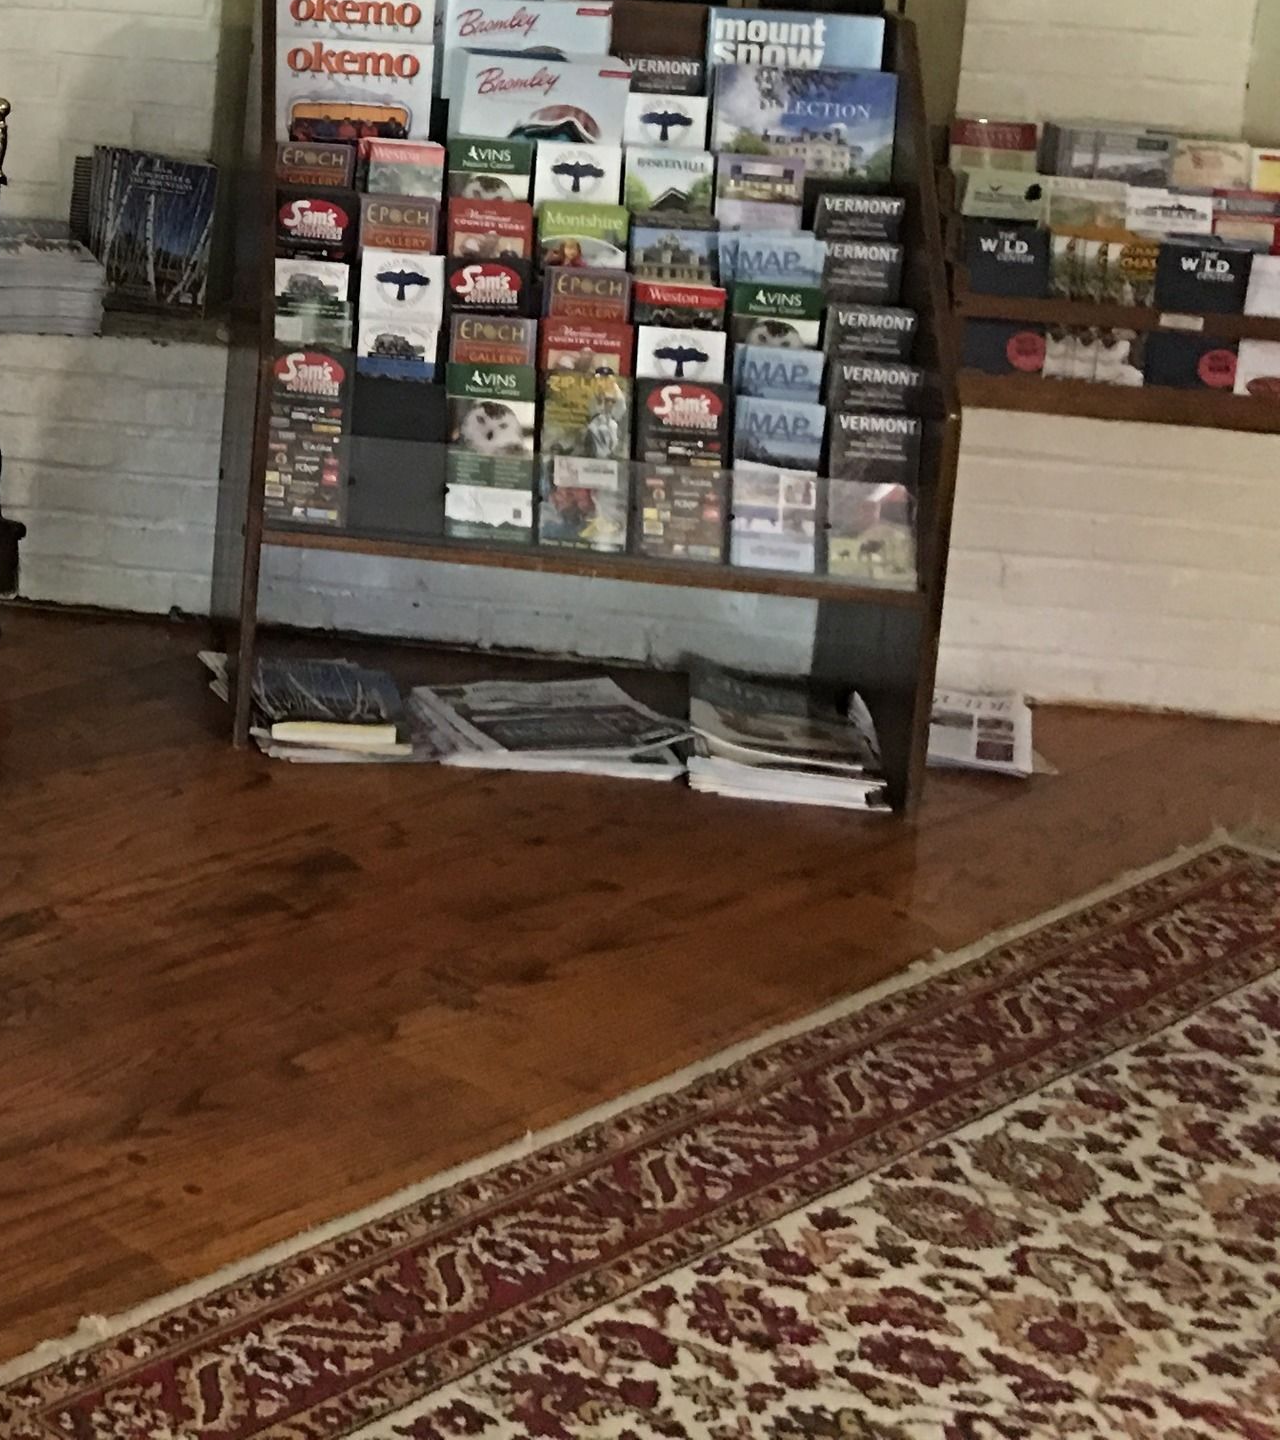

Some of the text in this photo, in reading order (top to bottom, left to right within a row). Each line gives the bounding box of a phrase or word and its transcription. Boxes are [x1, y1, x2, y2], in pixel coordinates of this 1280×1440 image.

[457, 6, 540, 37] Bromley
[714, 16, 827, 45] mount
[287, 41, 420, 78] okemo
[629, 57, 700, 76] VERMONT
[712, 41, 824, 69] snow
[476, 66, 560, 96] Bromley
[478, 148, 512, 162] VINS
[283, 199, 338, 227] Sam's
[824, 197, 901, 215] VERMONT
[546, 211, 624, 231] Montshire
[375, 236, 428, 248] GALLERY
[825, 243, 901, 263] VERMONT
[740, 249, 802, 274] MAP
[456, 264, 511, 293] Sam's
[648, 287, 700, 305] Weston
[767, 292, 803, 307] VINS
[838, 311, 915, 331] VERMONT
[278, 353, 333, 381] Sam's
[748, 361, 809, 386] MAP
[842, 365, 920, 387] VERMONT
[482, 372, 517, 388] VINS
[653, 385, 711, 414] Sam's
[748, 413, 810, 440] MAP
[840, 415, 917, 435] VERMONT
